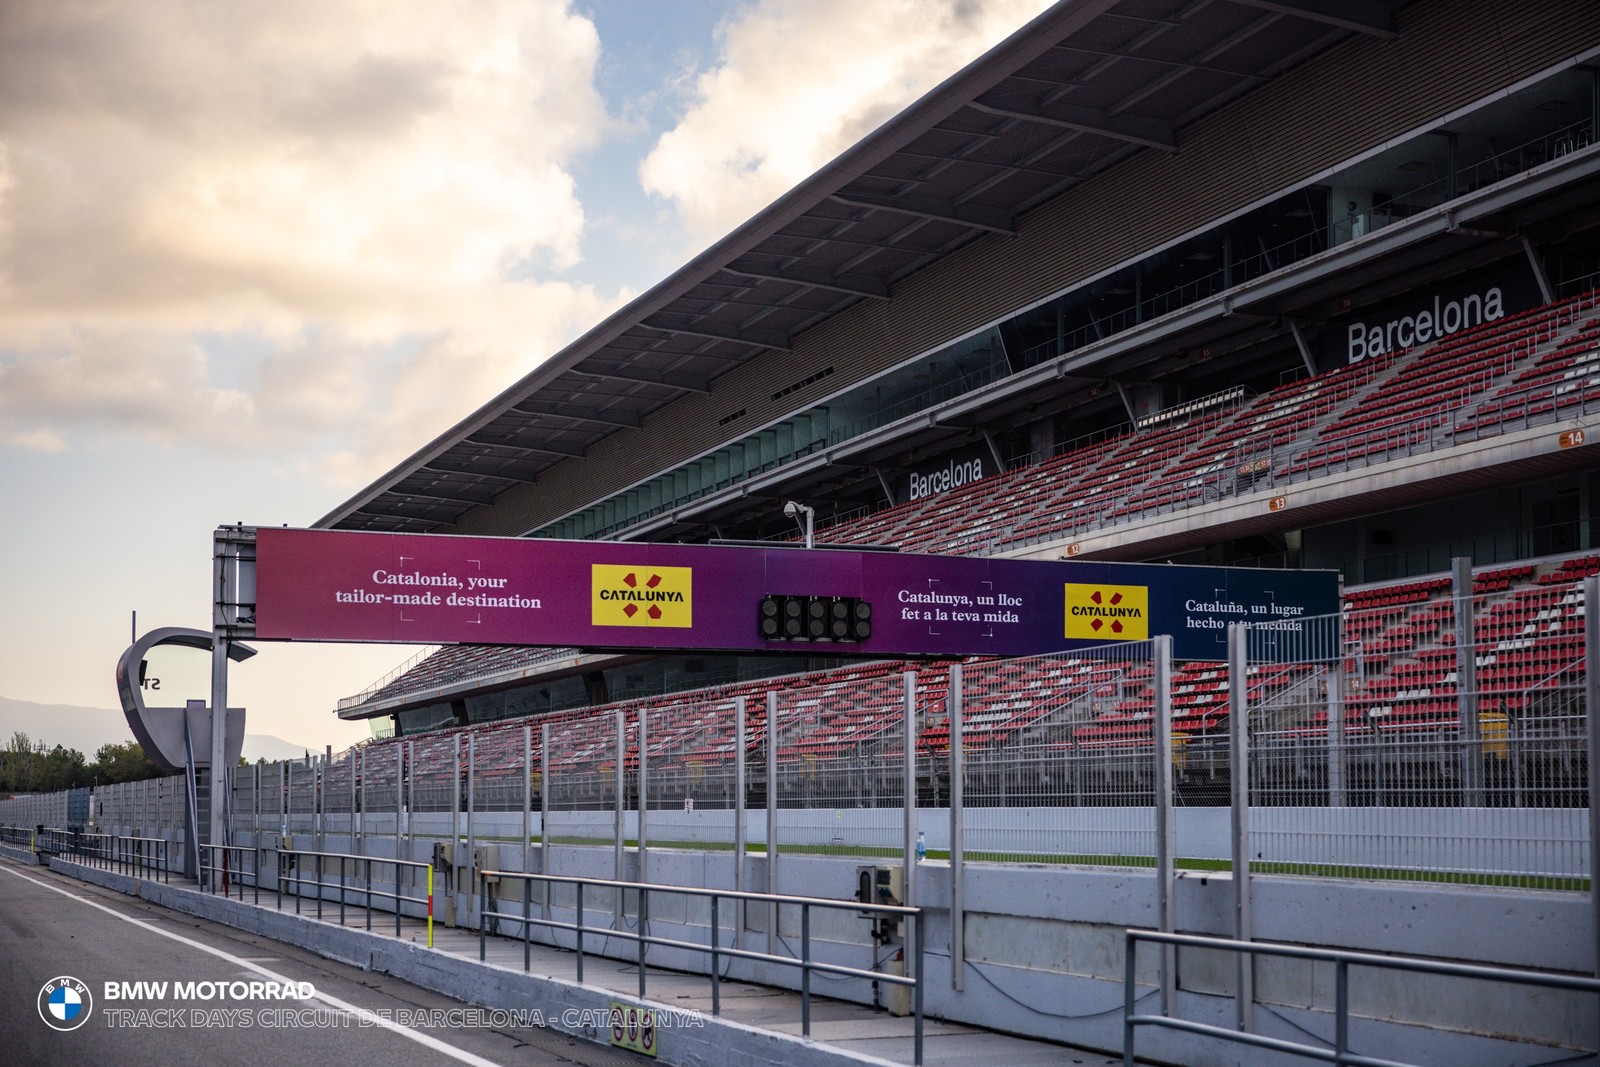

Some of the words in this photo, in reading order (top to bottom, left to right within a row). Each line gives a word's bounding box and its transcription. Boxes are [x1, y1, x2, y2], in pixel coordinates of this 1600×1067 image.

[1348, 287, 1504, 365] Barcelona
[1569, 431, 1583, 445] 14
[910, 458, 982, 501] Barcelona
[1275, 497, 1285, 509] 13
[1072, 544, 1079, 554] 12
[372, 569, 464, 590] Catalonia,
[467, 577, 508, 591] your
[335, 589, 442, 606] tailor-made
[446, 592, 542, 609] destination
[600, 589, 684, 602] CATALUNYA
[898, 590, 973, 606] Catalunya,
[976, 595, 995, 606] un
[997, 594, 1023, 606] lloc
[901, 608, 920, 620] fet
[923, 611, 932, 620] a
[935, 608, 948, 621] la
[951, 610, 980, 622] teva
[983, 610, 1019, 623] mida
[1071, 606, 1141, 618] CATALUNYA
[1185, 600, 1248, 615] Cataluña,
[1251, 604, 1268, 614] un
[1270, 603, 1304, 617] lugar
[1186, 616, 1225, 629] hecho
[1255, 619, 1303, 631] medida
